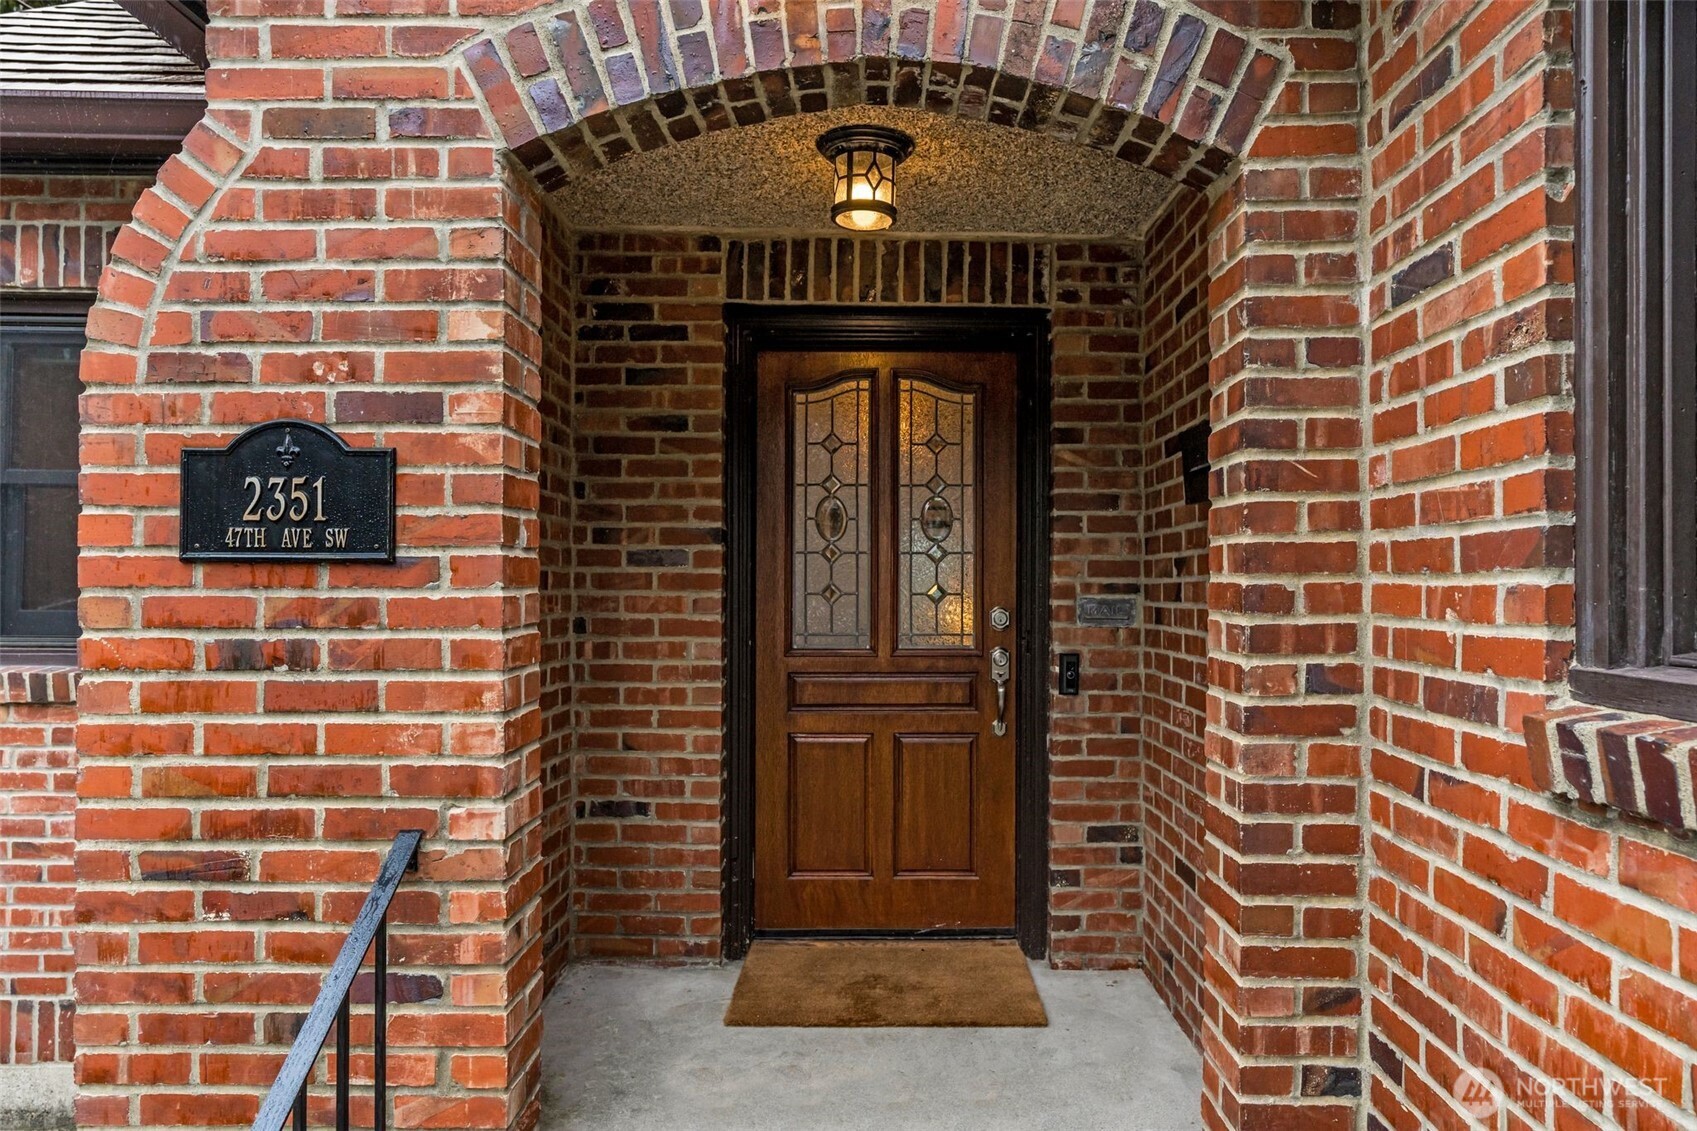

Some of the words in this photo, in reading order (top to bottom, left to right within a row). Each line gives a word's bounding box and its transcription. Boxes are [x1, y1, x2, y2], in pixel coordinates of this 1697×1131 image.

[242, 475, 327, 522] 2351
[225, 527, 267, 548] 47TH
[281, 527, 313, 548] AVE
[325, 527, 350, 548] SW
